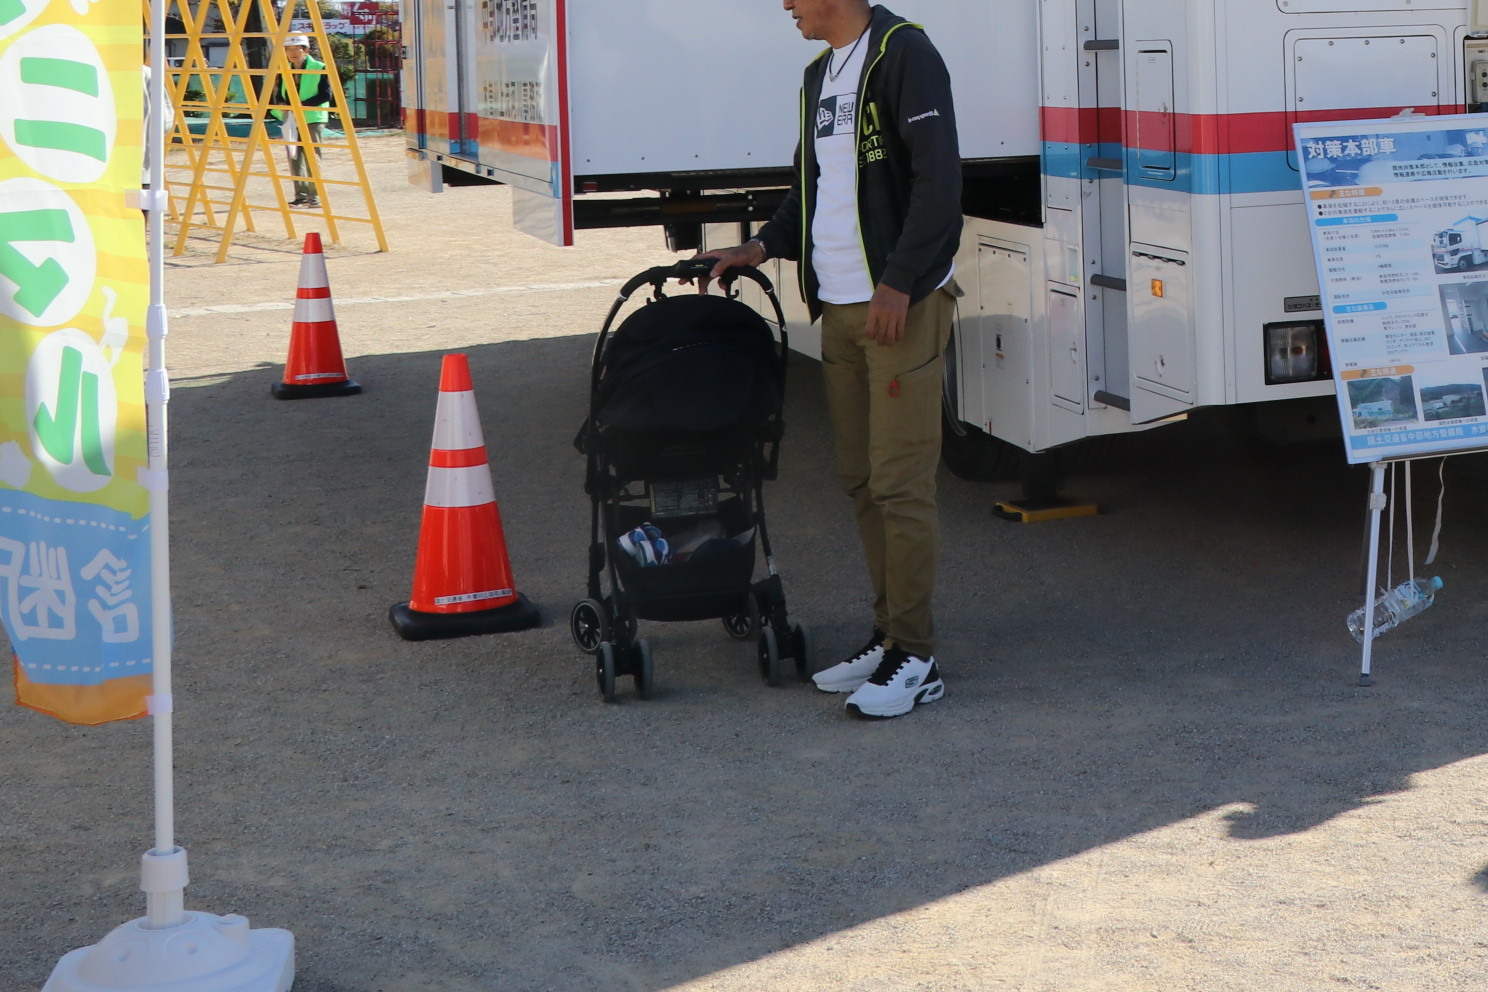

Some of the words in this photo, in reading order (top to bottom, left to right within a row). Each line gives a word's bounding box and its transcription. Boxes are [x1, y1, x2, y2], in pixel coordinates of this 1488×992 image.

[838, 101, 855, 114] NEW
[836, 113, 853, 126] ERA
[1307, 136, 1397, 159] 対策本部車
